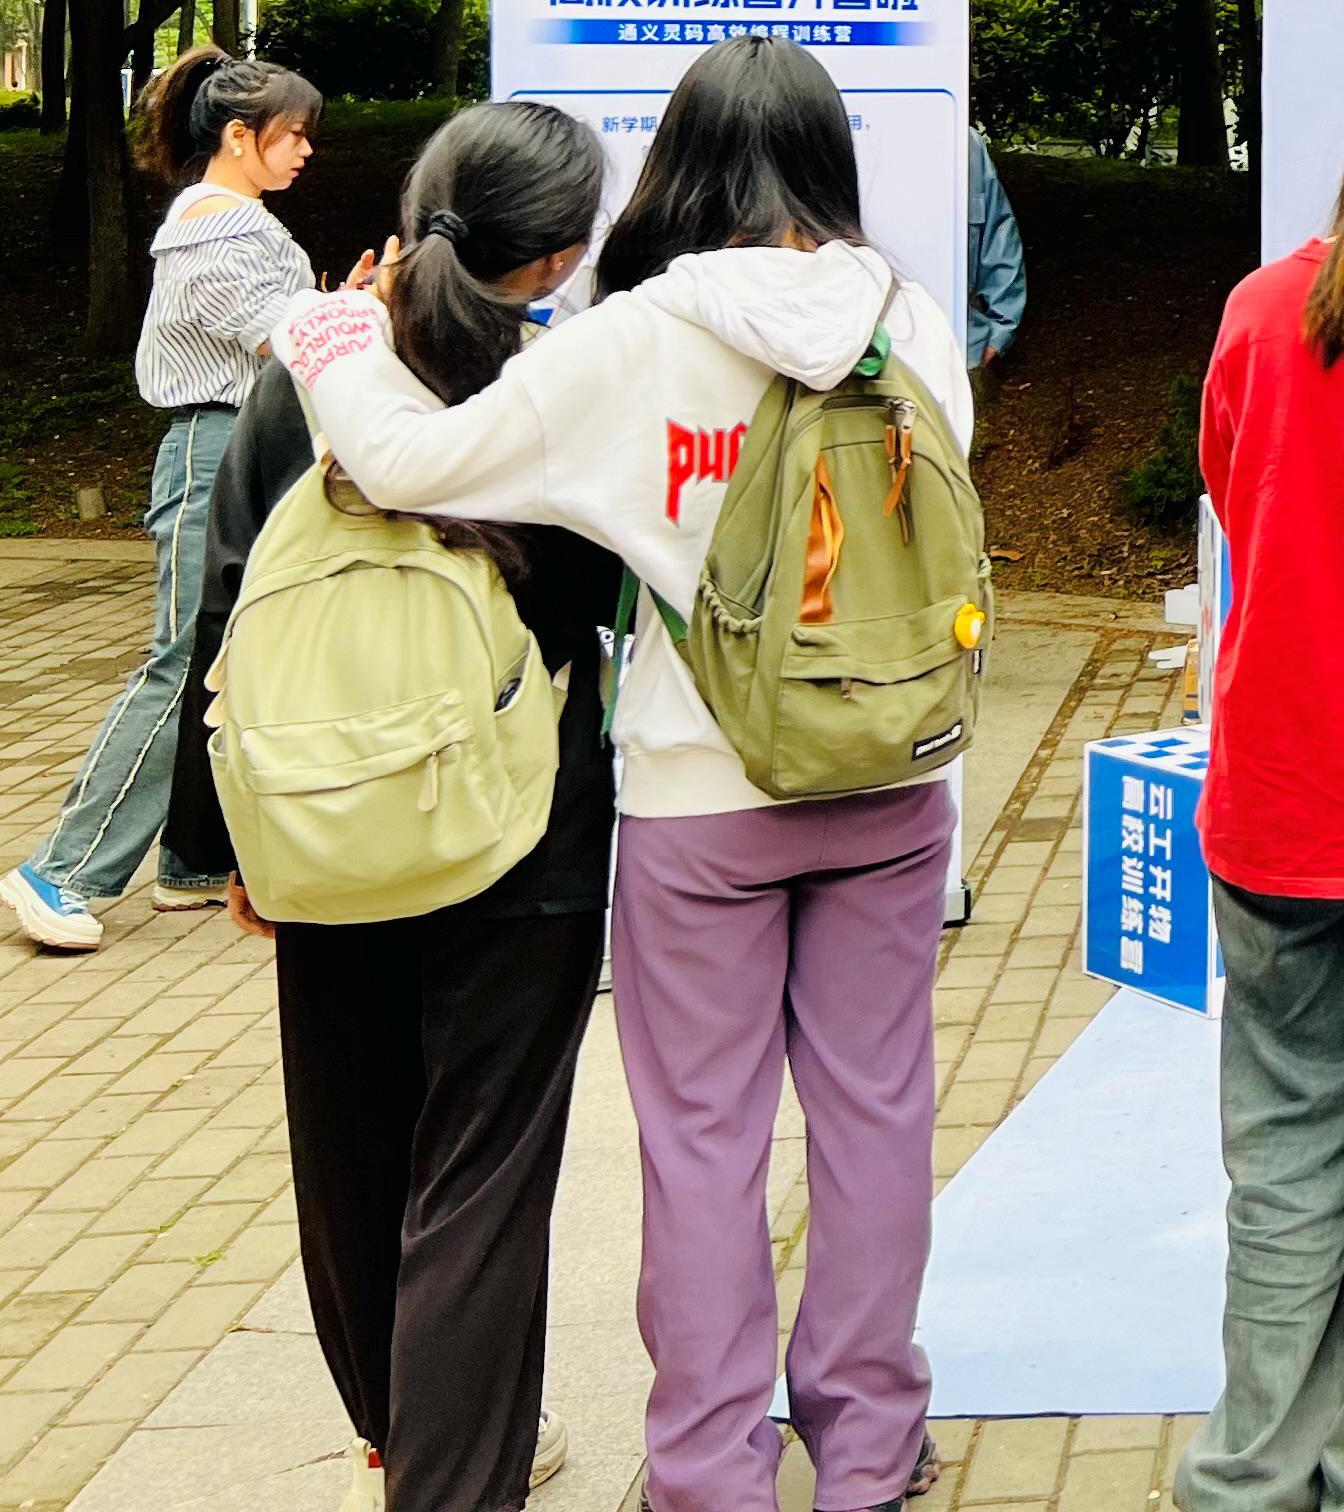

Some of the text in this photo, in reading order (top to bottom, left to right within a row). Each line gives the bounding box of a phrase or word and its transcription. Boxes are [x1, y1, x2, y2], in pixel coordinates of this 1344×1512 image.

[602, 116, 658, 133] 新学期
[1120, 775, 1145, 976] 高校训练营
[1148, 781, 1174, 945] 云工开物
